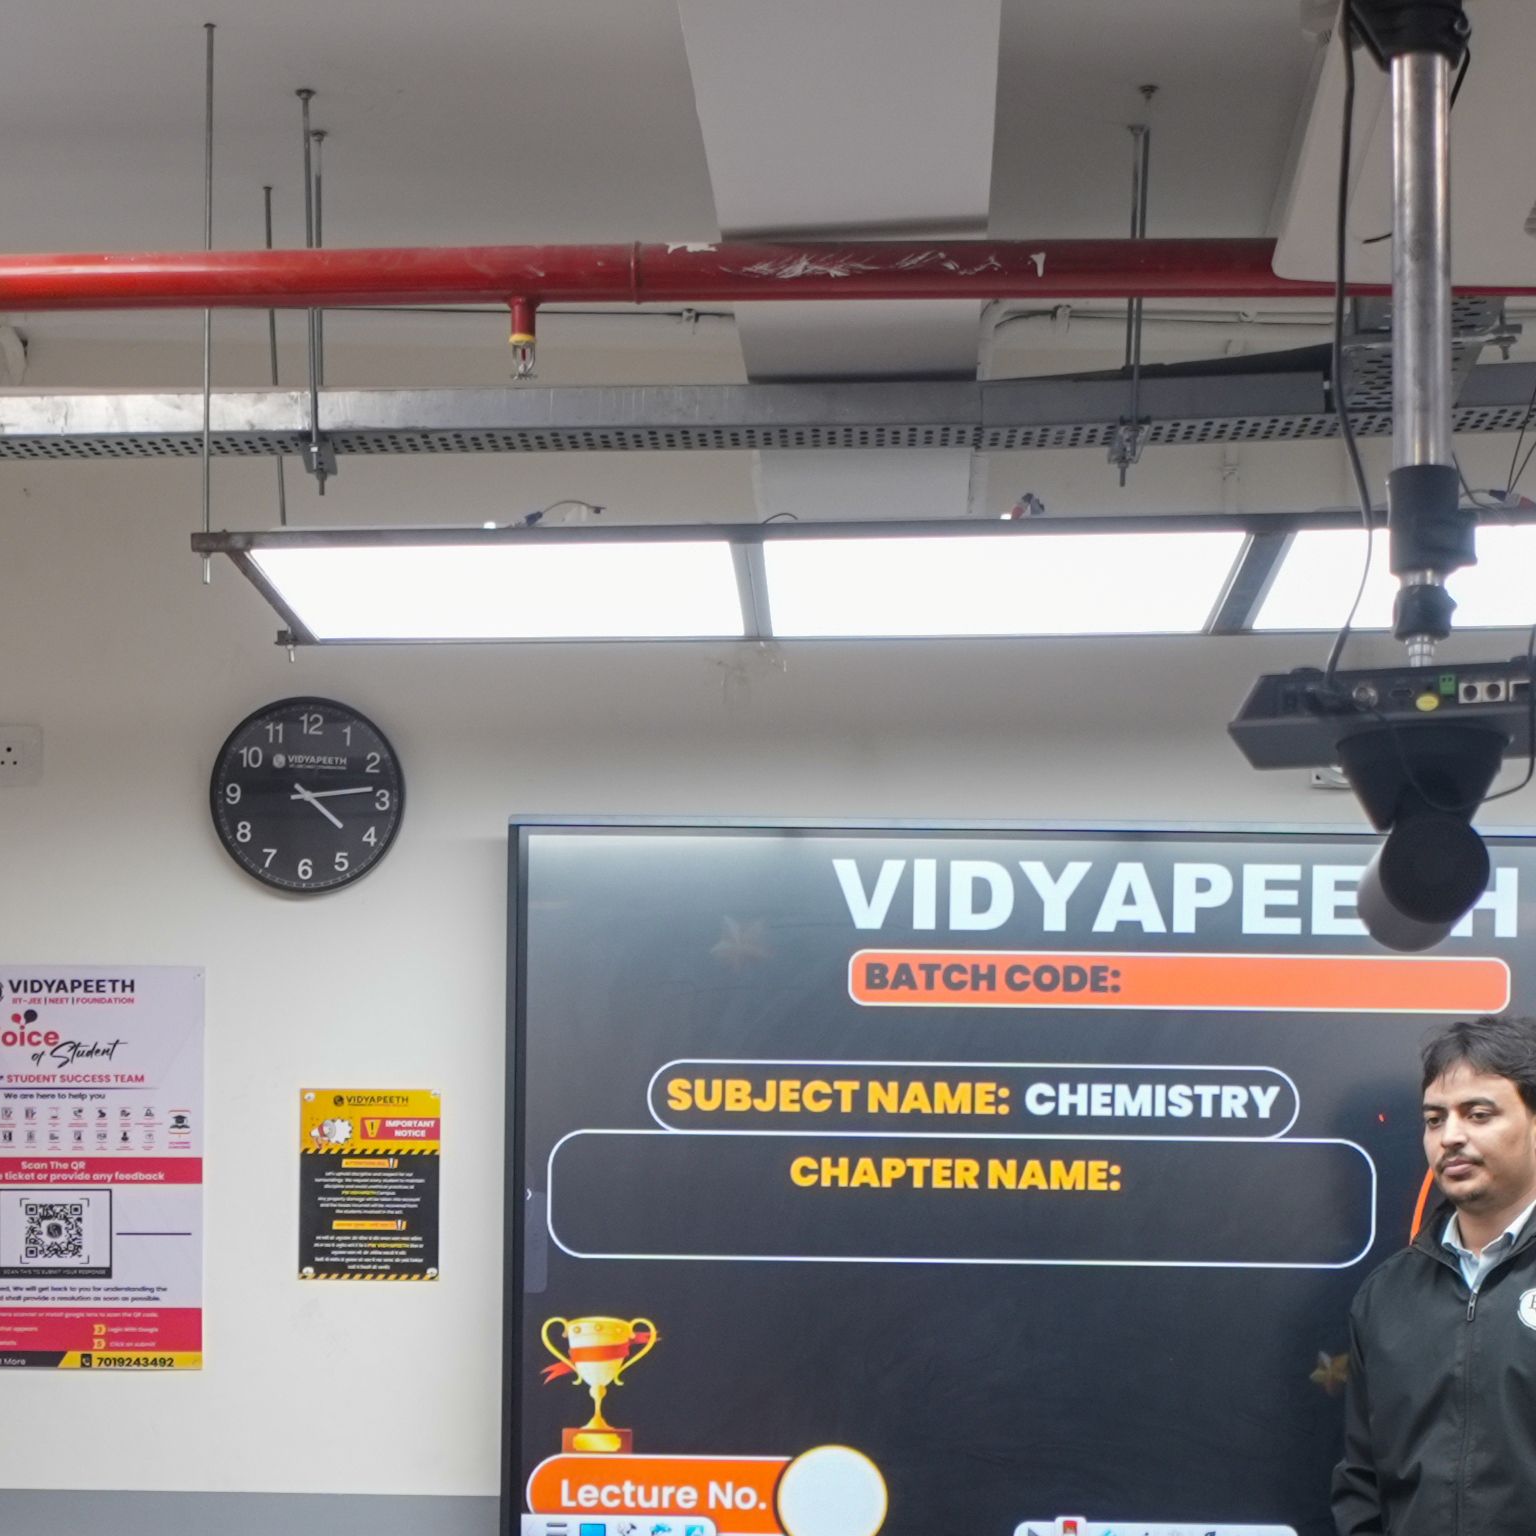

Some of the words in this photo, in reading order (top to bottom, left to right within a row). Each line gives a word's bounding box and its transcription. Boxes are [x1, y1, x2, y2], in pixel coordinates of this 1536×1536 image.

[265, 723, 284, 743] 11
[300, 713, 323, 735] 12
[341, 725, 352, 747] 1
[239, 746, 263, 768] 10
[287, 754, 348, 765] VIDYAPEETH
[365, 752, 381, 773] 2
[226, 783, 241, 804] 9
[375, 789, 390, 811] 3
[236, 821, 252, 843] 8
[362, 826, 378, 847] 4
[262, 848, 278, 868] 7
[334, 852, 349, 872] 5
[297, 858, 313, 880] 6
[832, 857, 1519, 939] VIDYAPEEH
[9, 979, 135, 994] VIDYAPEETH
[865, 963, 997, 993] BATCH
[1004, 965, 1122, 994] CODE:
[49, 997, 69, 1005] NEET
[76, 997, 135, 1005] FOUNDATION
[31, 1051, 47, 1067] of
[50, 1039, 129, 1069] Student
[7, 1074, 57, 1083] STUDENT
[60, 1074, 110, 1083] SUCCESS
[114, 1074, 144, 1083] TEAM
[4, 1092, 18, 1100] We
[36, 1092, 56, 1100] here
[68, 1092, 88, 1102] help
[90, 1094, 105, 1102] you
[346, 1096, 409, 1104] VIDYAPEETH
[666, 1077, 859, 1116] SUBJECT
[868, 1080, 1010, 1116] NAME:
[1024, 1085, 1281, 1120] CHEMISTRY
[385, 1120, 436, 1128] IMPORTANT
[21, 1161, 48, 1169] Scan
[51, 1161, 69, 1169] The
[71, 1161, 86, 1170] QR
[789, 1158, 978, 1191] CHAPTER
[987, 1160, 1121, 1192] NAME:
[4, 1172, 35, 1180] ticket
[50, 1172, 91, 1182] provide
[93, 1174, 113, 1183] any
[115, 1172, 165, 1181] feedback
[4, 1358, 26, 1366] More
[97, 1357, 174, 1368] 7019243492
[560, 1479, 698, 1509] Lecture
[709, 1482, 767, 1511] No.
